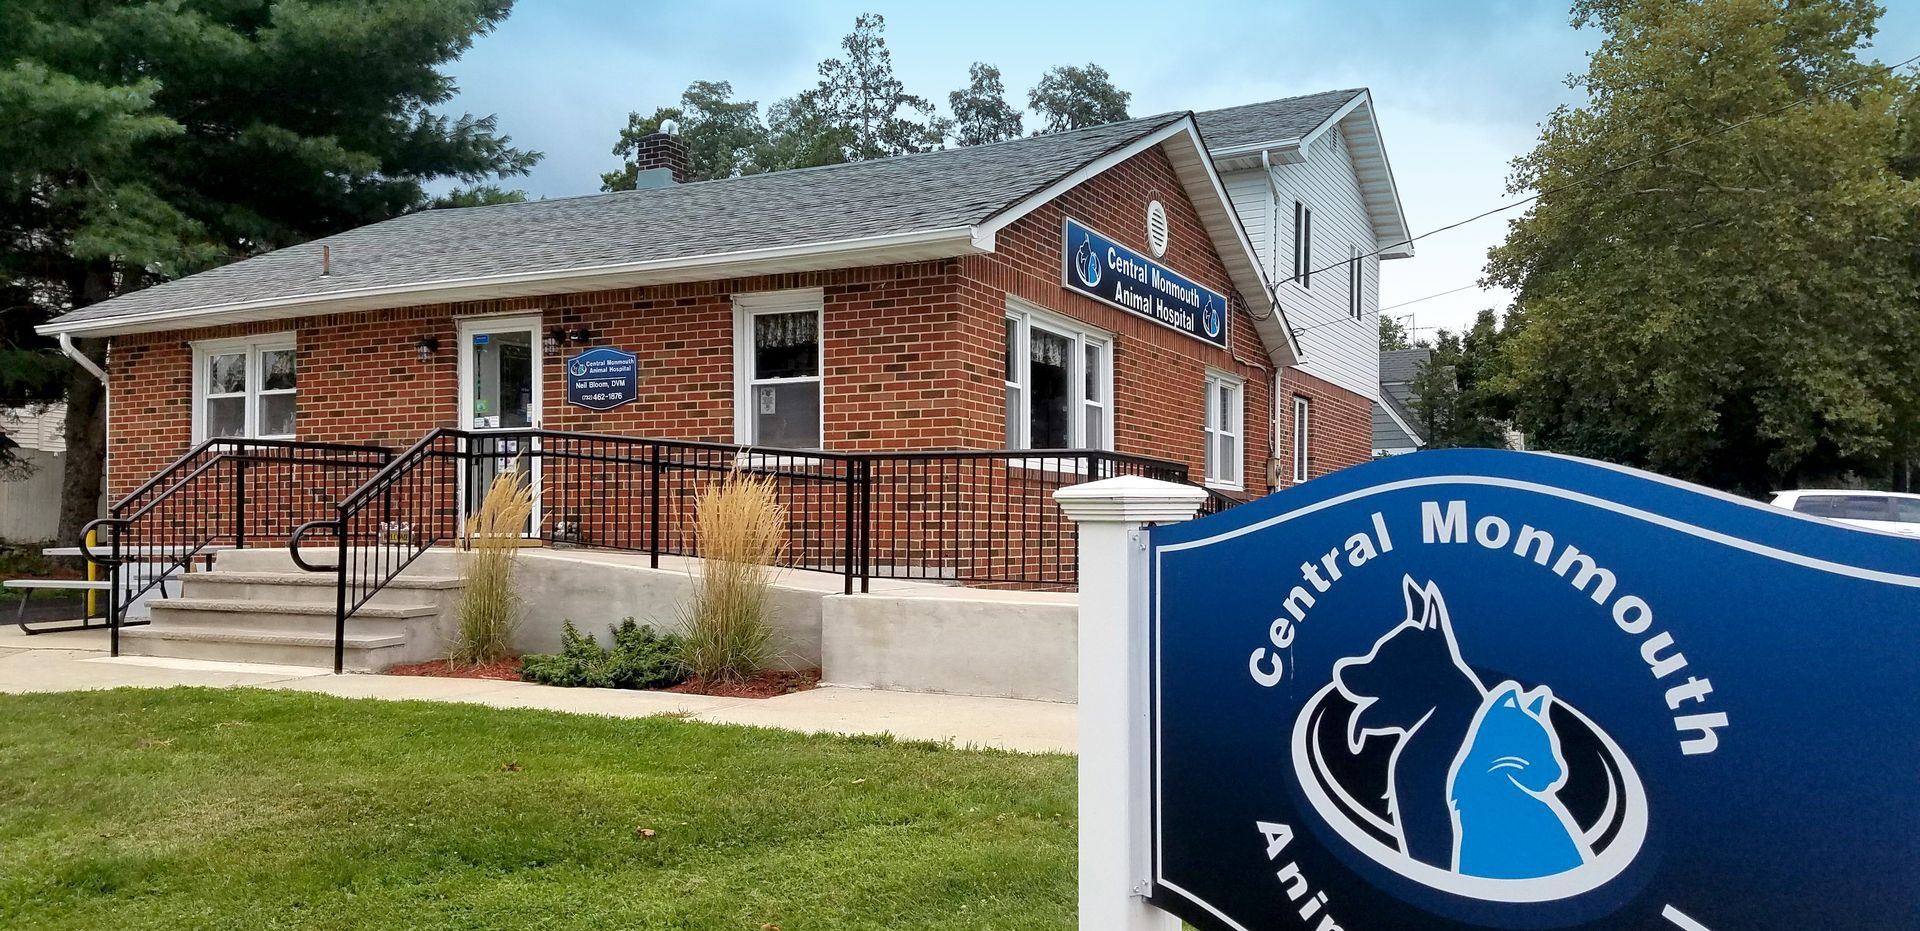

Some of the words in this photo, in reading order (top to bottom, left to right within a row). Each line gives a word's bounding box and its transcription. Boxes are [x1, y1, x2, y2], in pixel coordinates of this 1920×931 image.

[1107, 246, 1148, 285] Central
[1151, 267, 1200, 309] Monmouth
[1115, 280, 1152, 315] Animal
[1156, 297, 1195, 332] Hospital
[1249, 511, 1393, 687] Central
[1421, 500, 1729, 756] Monmouth
